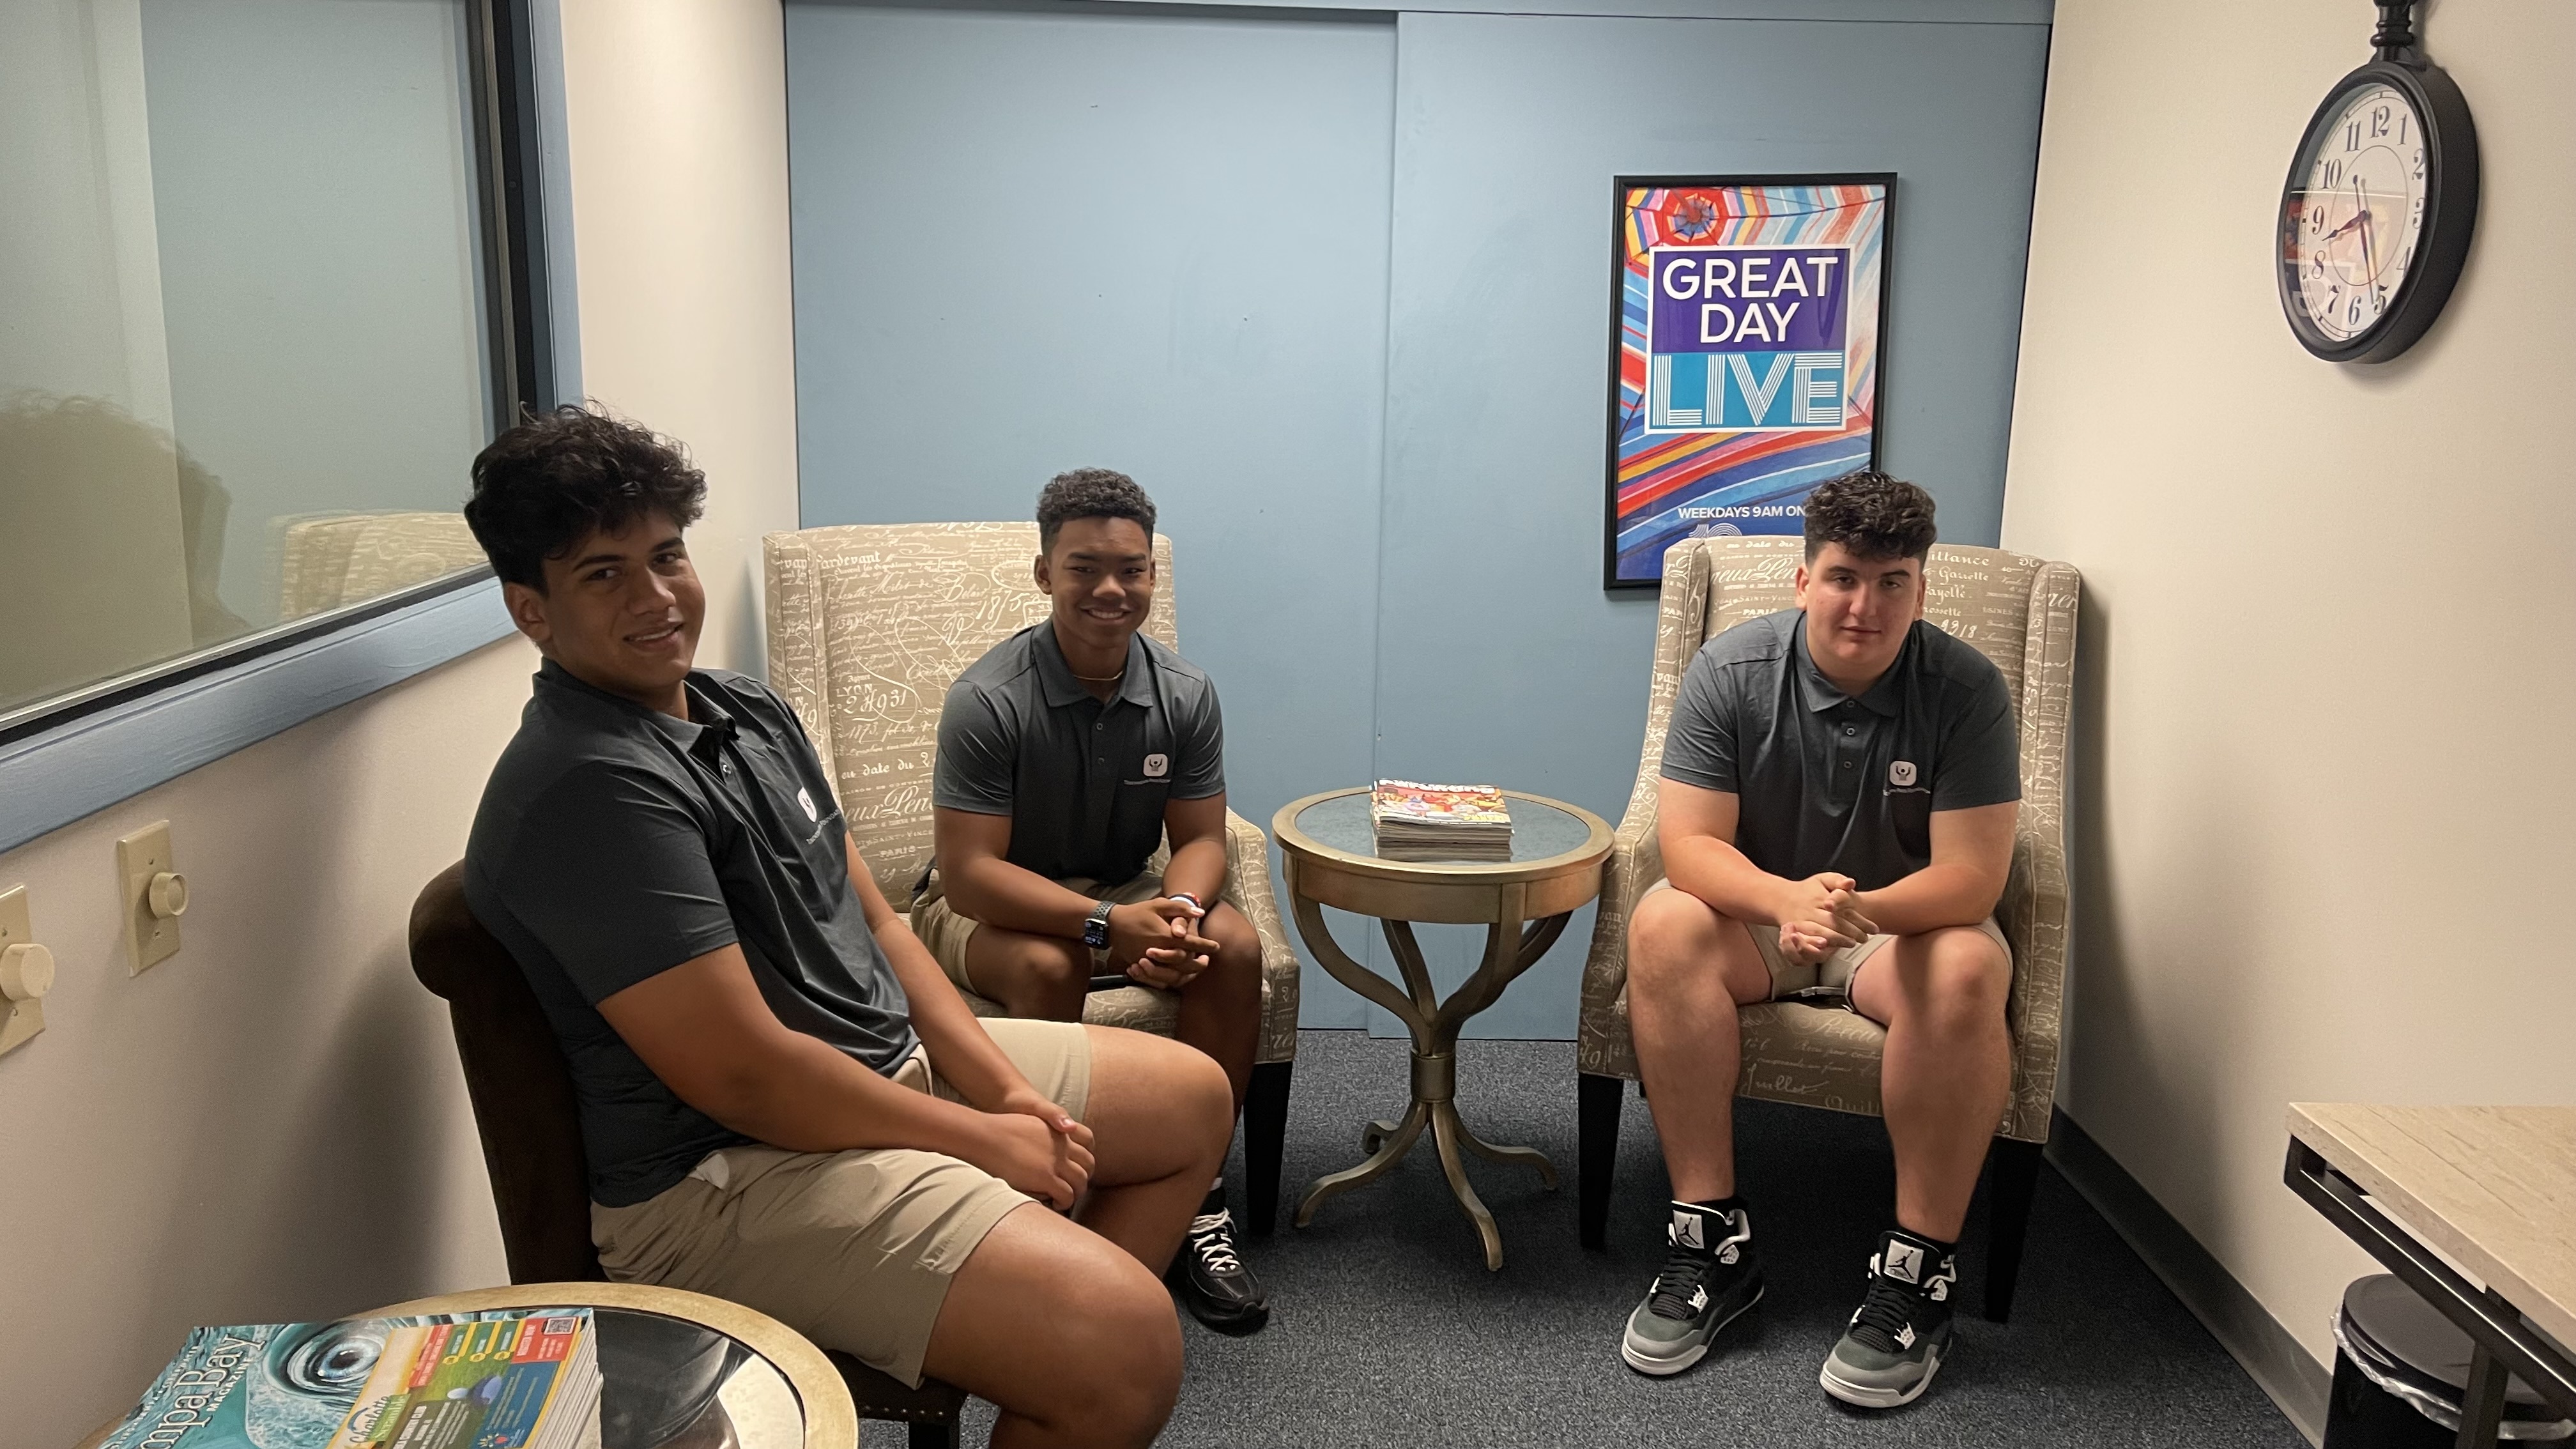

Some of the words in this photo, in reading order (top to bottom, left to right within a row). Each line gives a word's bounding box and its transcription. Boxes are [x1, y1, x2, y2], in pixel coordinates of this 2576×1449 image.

[2345, 120, 2361, 152] 11
[2370, 105, 2390, 139] 12
[2397, 113, 2407, 146] 1
[2320, 158, 2342, 189] 10
[2411, 148, 2425, 181] 2
[2312, 205, 2325, 234] 9
[2412, 197, 2426, 229] 3
[1662, 256, 1838, 300] GREAT
[2311, 250, 2326, 280] 8
[2395, 246, 2412, 279] 4
[2327, 284, 2341, 314] 7
[2348, 295, 2362, 325] 6
[2373, 284, 2389, 316] 5
[1699, 302, 1800, 344] DAY
[1653, 352, 1843, 426] LIVE
[1678, 507, 1751, 519] WEEKDAYS
[1752, 505, 1783, 518] 9AM
[1786, 505, 1806, 516] ON
[172, 1333, 266, 1389] Bay
[206, 1356, 254, 1413] MAGAZINE
